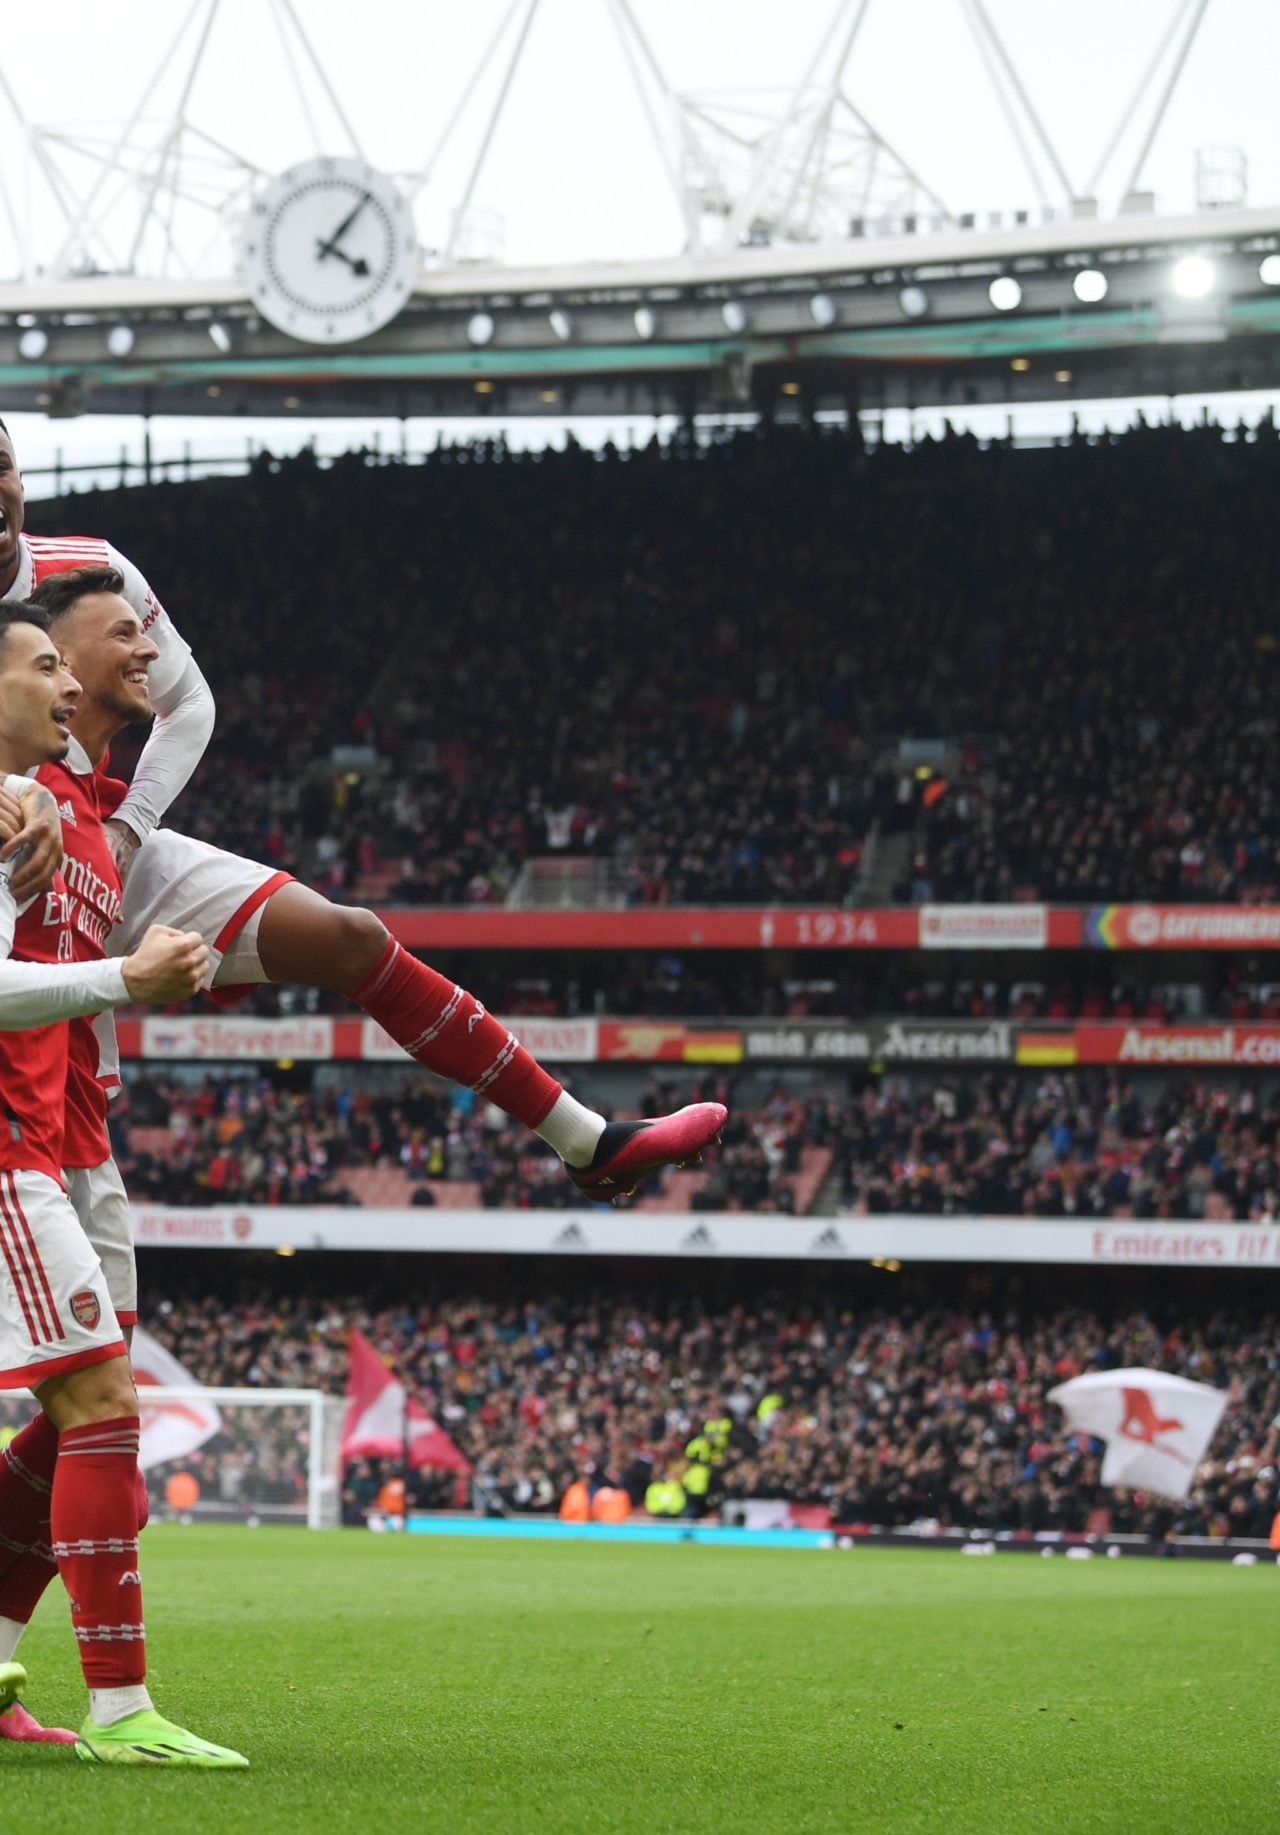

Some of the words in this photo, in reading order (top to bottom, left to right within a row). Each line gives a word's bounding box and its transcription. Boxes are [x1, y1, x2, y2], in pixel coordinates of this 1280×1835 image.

[796, 911, 877, 944] 1934
[192, 1022, 326, 1052] Slovenia
[1092, 1229, 1226, 1258] Emirates
